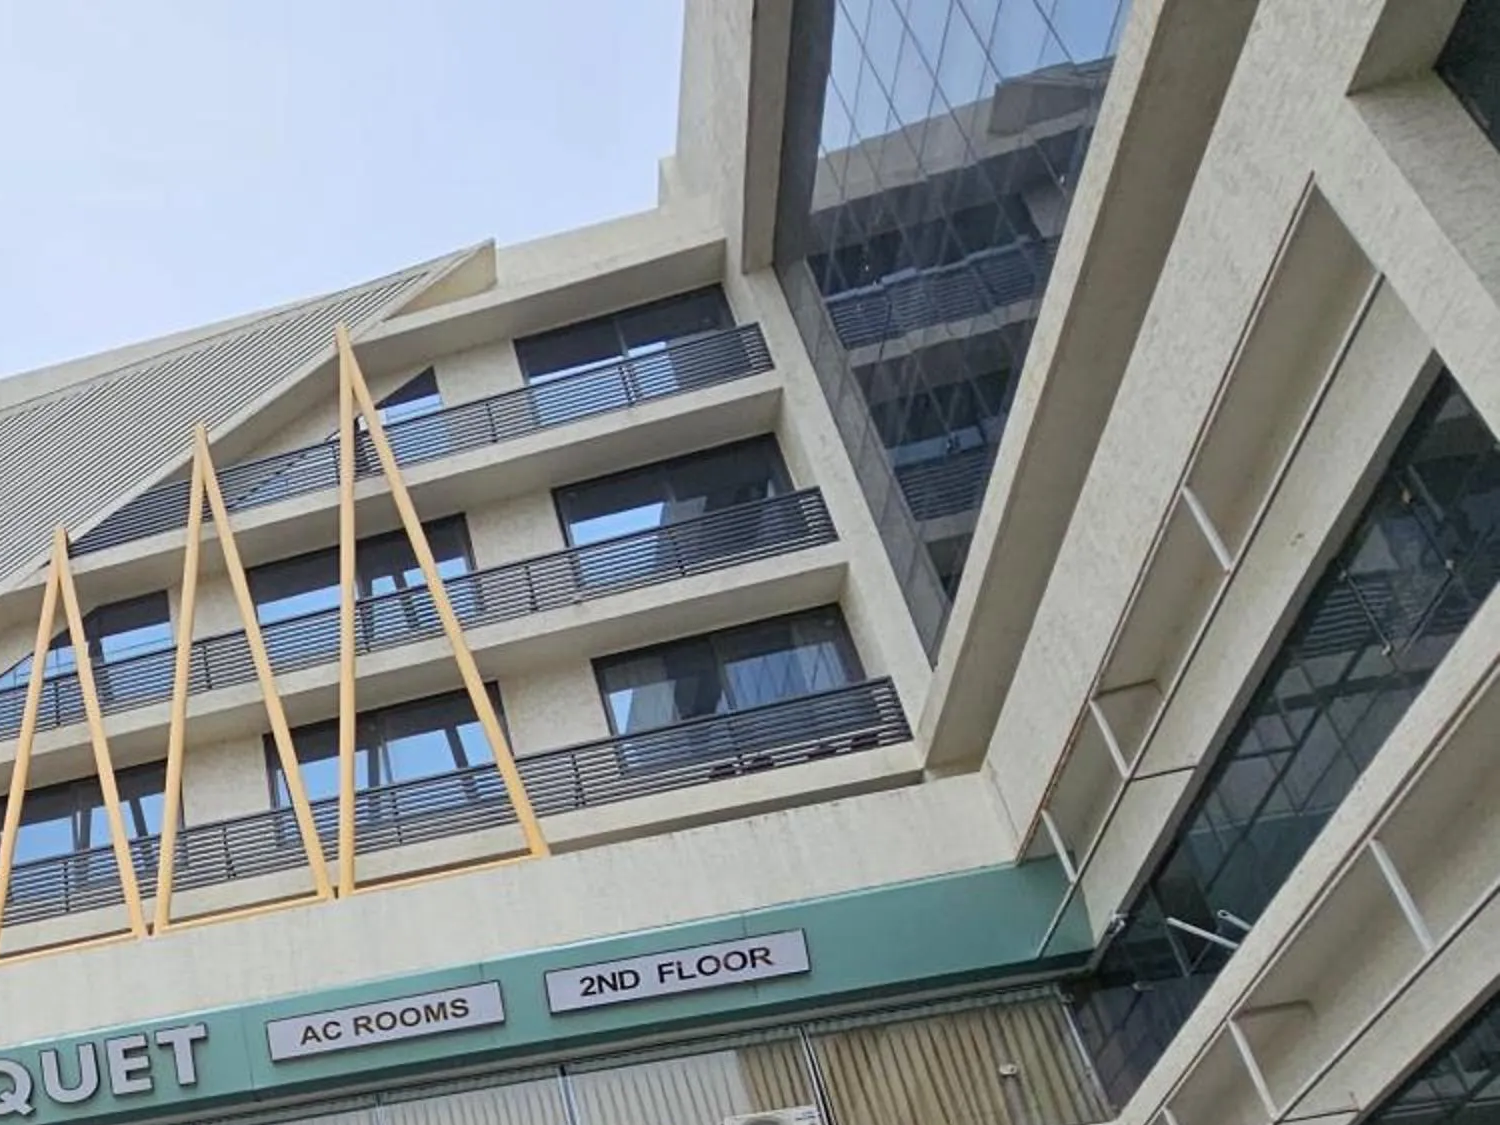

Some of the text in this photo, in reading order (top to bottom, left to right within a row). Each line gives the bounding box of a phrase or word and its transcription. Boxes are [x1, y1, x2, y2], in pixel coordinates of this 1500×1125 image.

[580, 945, 774, 998] 2ND FLOOR
[300, 997, 471, 1046] AC ROOMS
